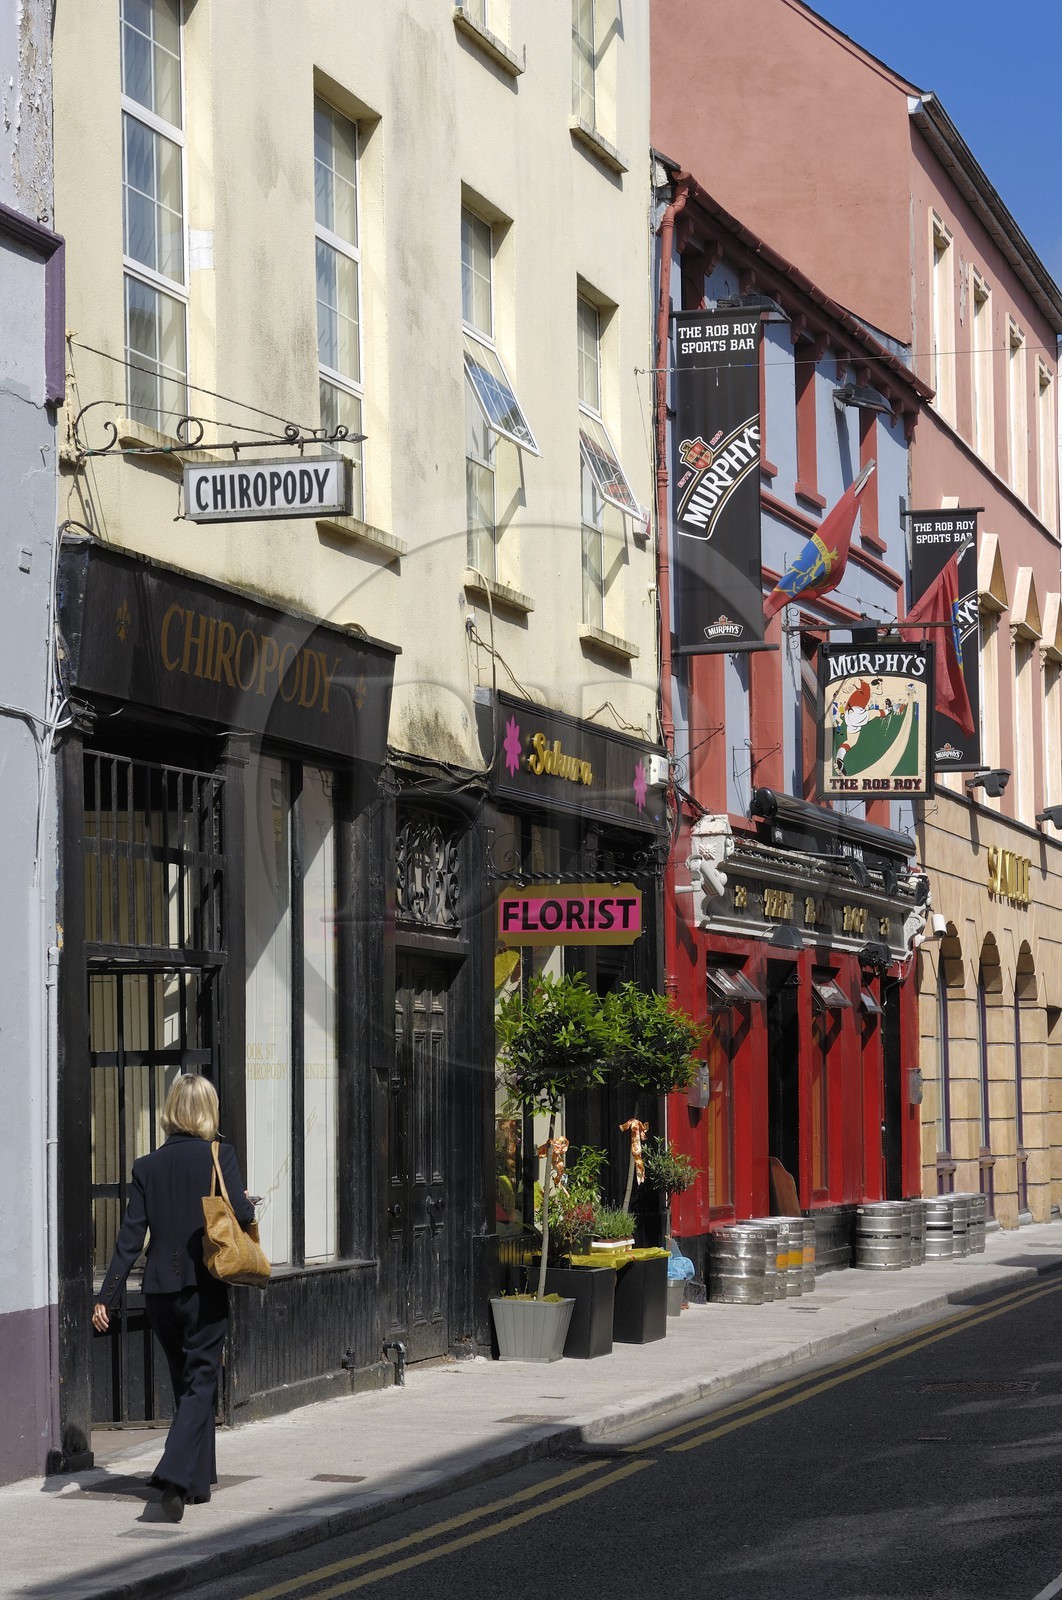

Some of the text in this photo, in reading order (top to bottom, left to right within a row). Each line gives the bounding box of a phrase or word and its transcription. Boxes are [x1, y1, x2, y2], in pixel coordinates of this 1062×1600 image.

[678, 322, 757, 339] THE ROB ROY
[681, 338, 755, 354] SPORTS BAR
[195, 467, 331, 511] CHIROPODY
[913, 520, 975, 532] THE ROB ROY
[916, 533, 951, 544] SPORTS
[160, 603, 342, 714] CHIROPODY
[828, 653, 927, 680] MURPHY'S
[529, 732, 593, 786] Sakura
[830, 778, 922, 790] THE ROB ROY
[764, 888, 794, 920] THE
[502, 898, 637, 931] FLORIST
[246, 1042, 263, 1060] OOK
[246, 1063, 330, 1080] HIROPODY ENTRE
